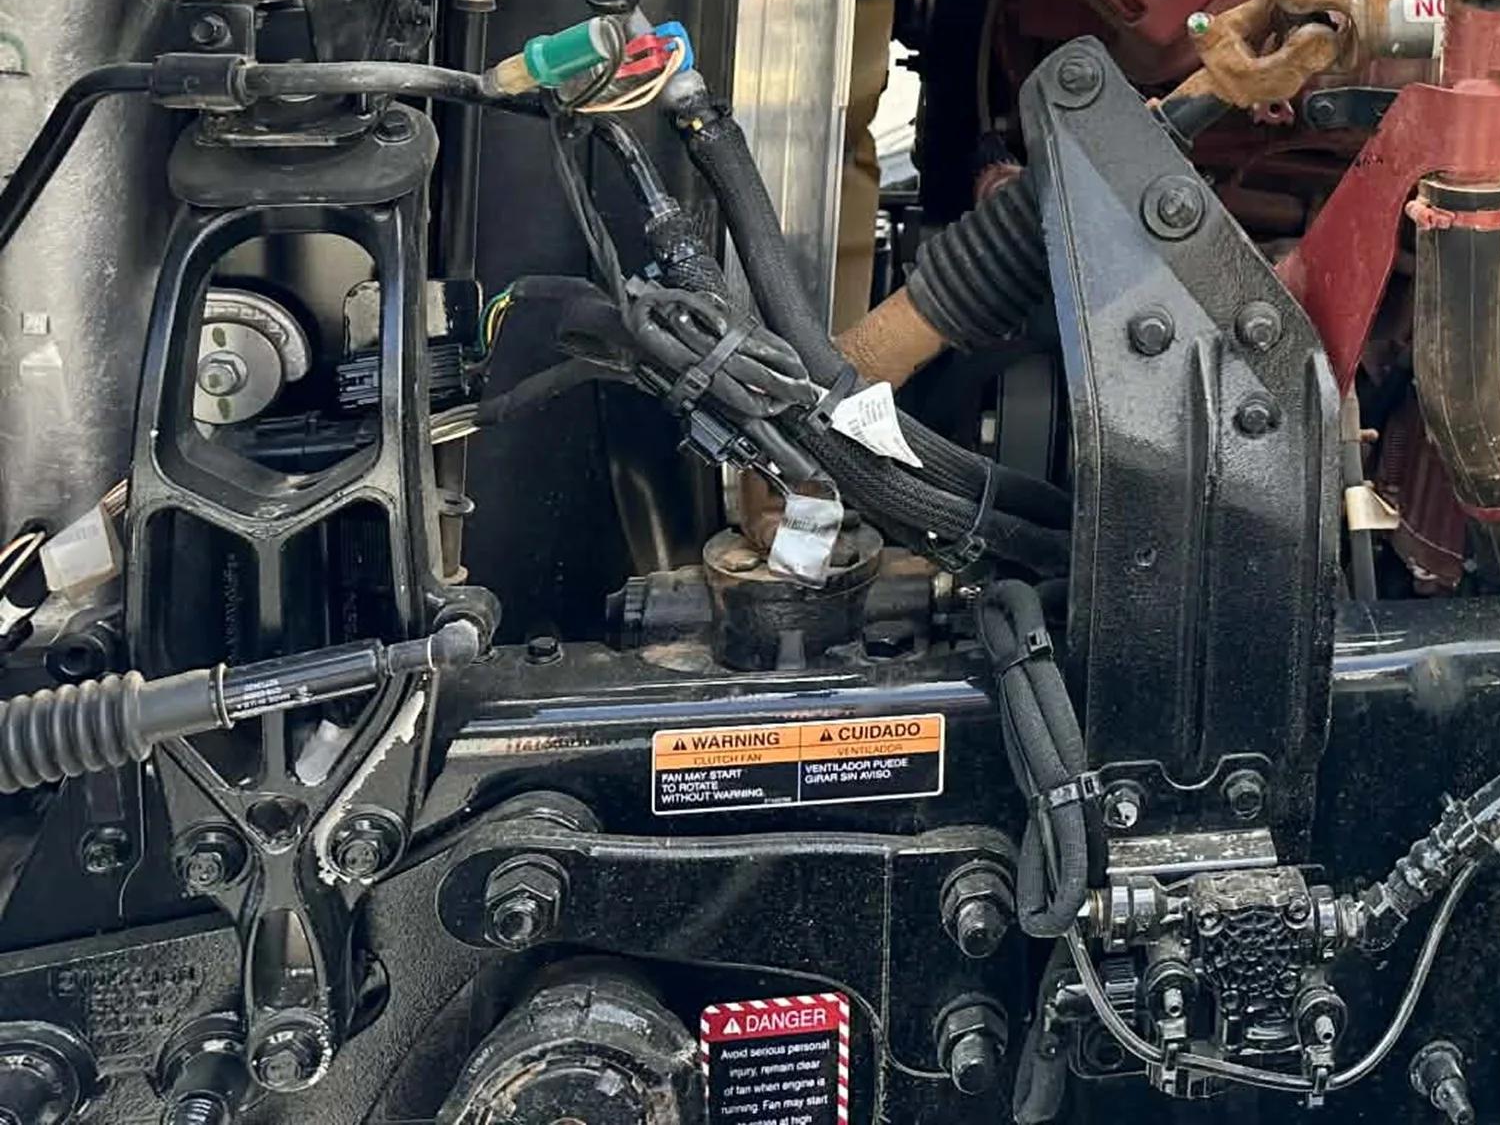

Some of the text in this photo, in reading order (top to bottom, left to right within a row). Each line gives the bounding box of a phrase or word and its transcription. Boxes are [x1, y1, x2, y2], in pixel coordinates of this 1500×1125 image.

[838, 722, 921, 741] CUIDADO
[691, 732, 780, 751] WARNING
[837, 743, 903, 756] VENTILADOR
[694, 753, 762, 765] CLUTCH FAN
[804, 757, 909, 773] VENTILADOR PUEDE
[661, 769, 743, 783] FAN MAY START
[804, 773, 838, 784] GIRAR
[840, 771, 857, 781] SIN
[661, 781, 718, 793] TO ROTATE
[661, 792, 710, 804] WITHOUT
[746, 1008, 827, 1032] DANGER
[720, 1038, 830, 1060] Avoid serious personal
[760, 1062, 795, 1075] remain
[796, 1059, 821, 1071] clear
[723, 1085, 734, 1096] of
[753, 1082, 780, 1093] when
[782, 1077, 815, 1092] engine
[762, 1099, 782, 1111] Fan
[783, 1097, 805, 1110] may
[806, 1094, 829, 1106] start
